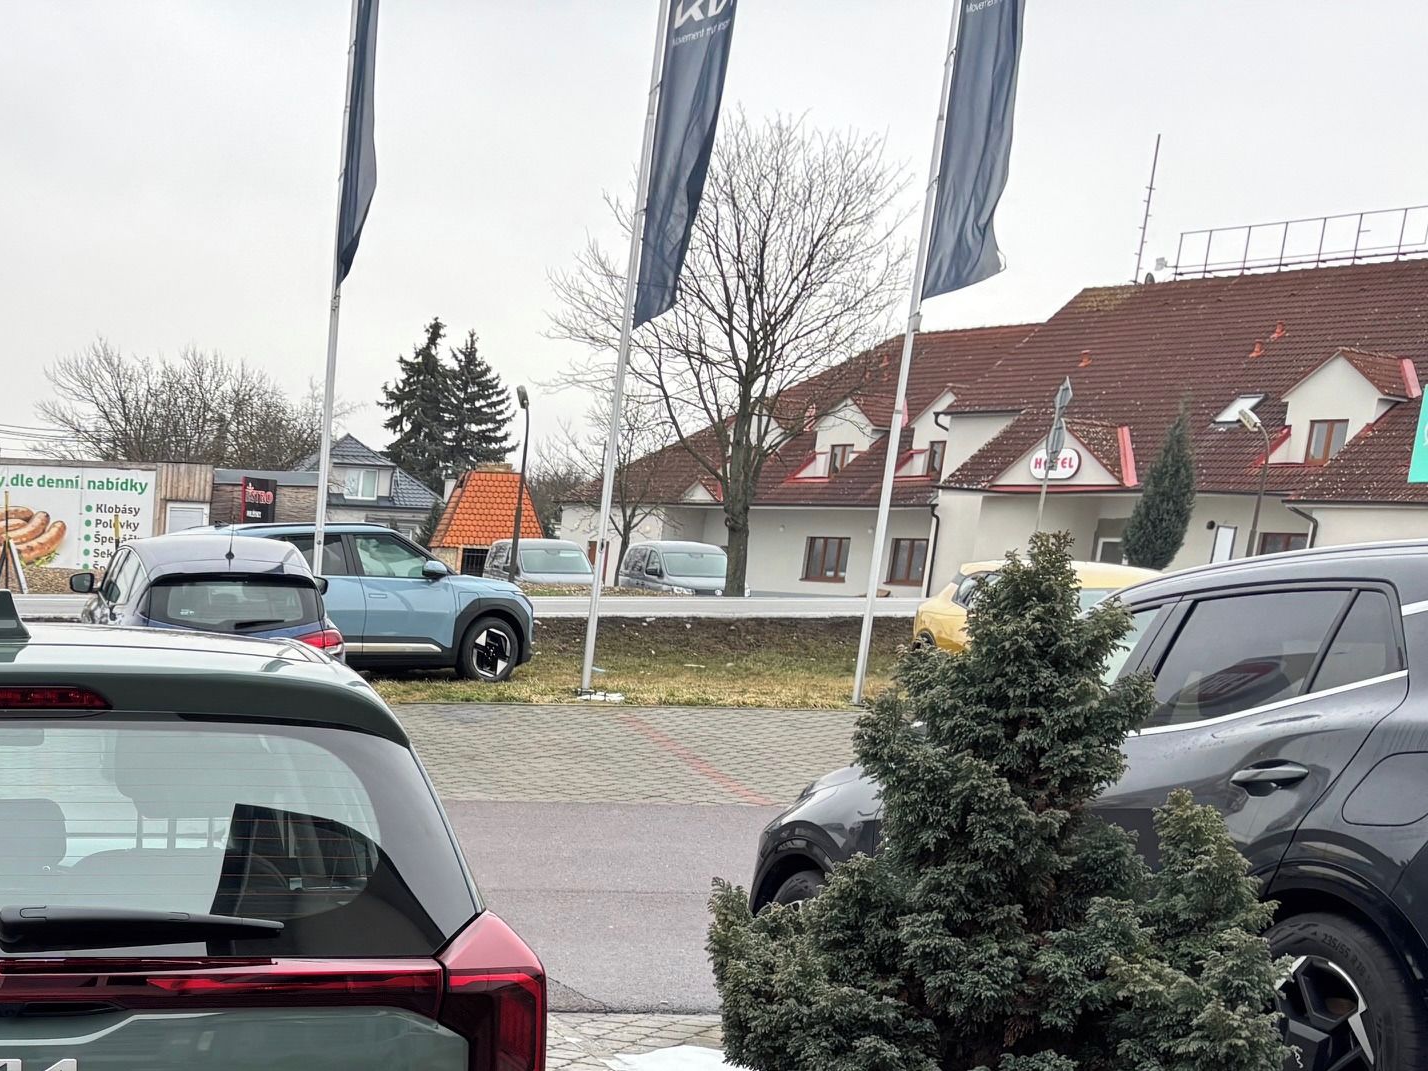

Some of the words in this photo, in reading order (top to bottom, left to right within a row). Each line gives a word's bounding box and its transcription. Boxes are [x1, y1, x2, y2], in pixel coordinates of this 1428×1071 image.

[1034, 456, 1074, 470] HEL
[10, 473, 34, 488] dle
[37, 475, 80, 490] denní
[87, 477, 149, 495] nabídky
[96, 503, 141, 517] Klobásy
[95, 518, 140, 532] Polvky
